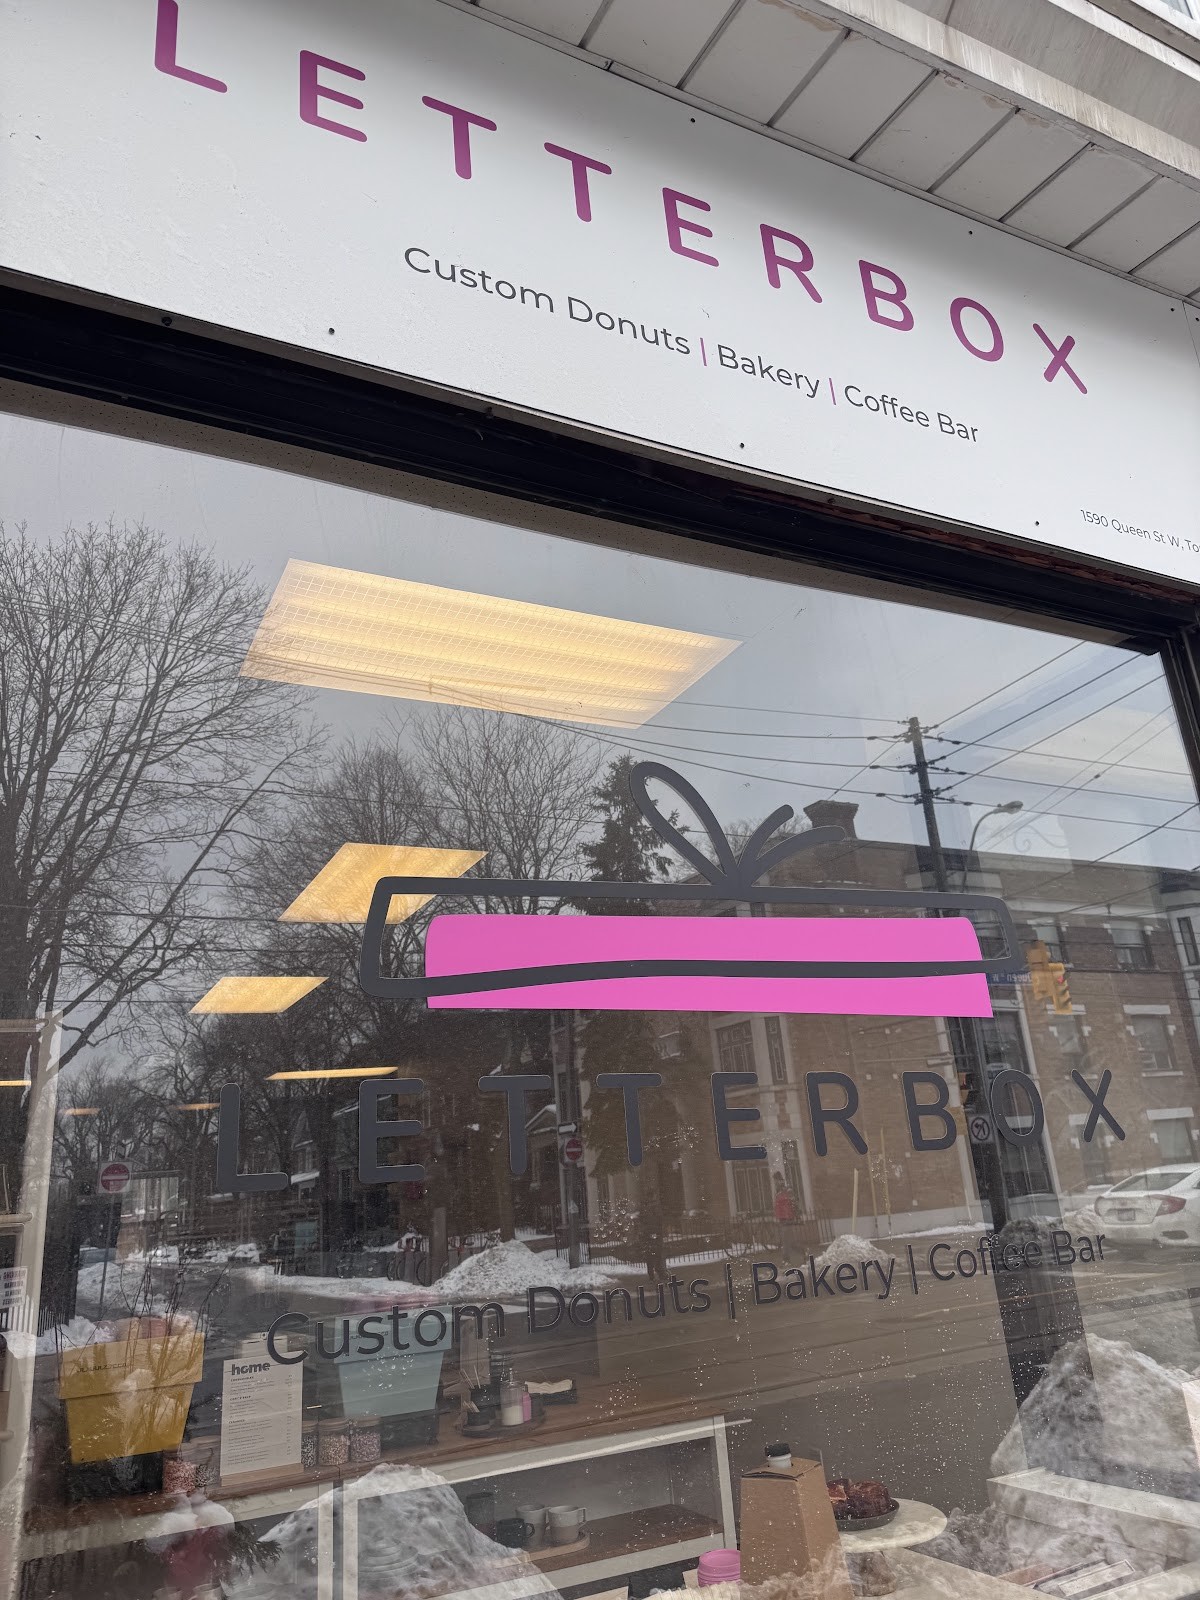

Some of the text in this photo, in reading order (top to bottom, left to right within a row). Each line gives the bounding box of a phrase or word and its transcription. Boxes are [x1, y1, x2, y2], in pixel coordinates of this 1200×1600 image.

[154, 0, 1089, 395] LETTERBOX
[403, 247, 554, 313] Custom
[567, 296, 691, 355] Donuts
[717, 344, 820, 399] Bakery
[844, 384, 931, 427] Coffee
[936, 412, 979, 443] Bar
[1080, 509, 1109, 527] 1590
[1111, 519, 1151, 540] Queen
[1152, 530, 1166, 544] St
[1184, 539, 1200, 553] To
[216, 1069, 1127, 1193] LETTERBOX
[266, 1301, 505, 1365] Custom
[526, 1273, 712, 1334] Donuts
[751, 1256, 896, 1305] Bakery
[928, 1234, 1044, 1282] Coffee
[1049, 1230, 1107, 1266] Bar
[231, 1362, 271, 1376] home
